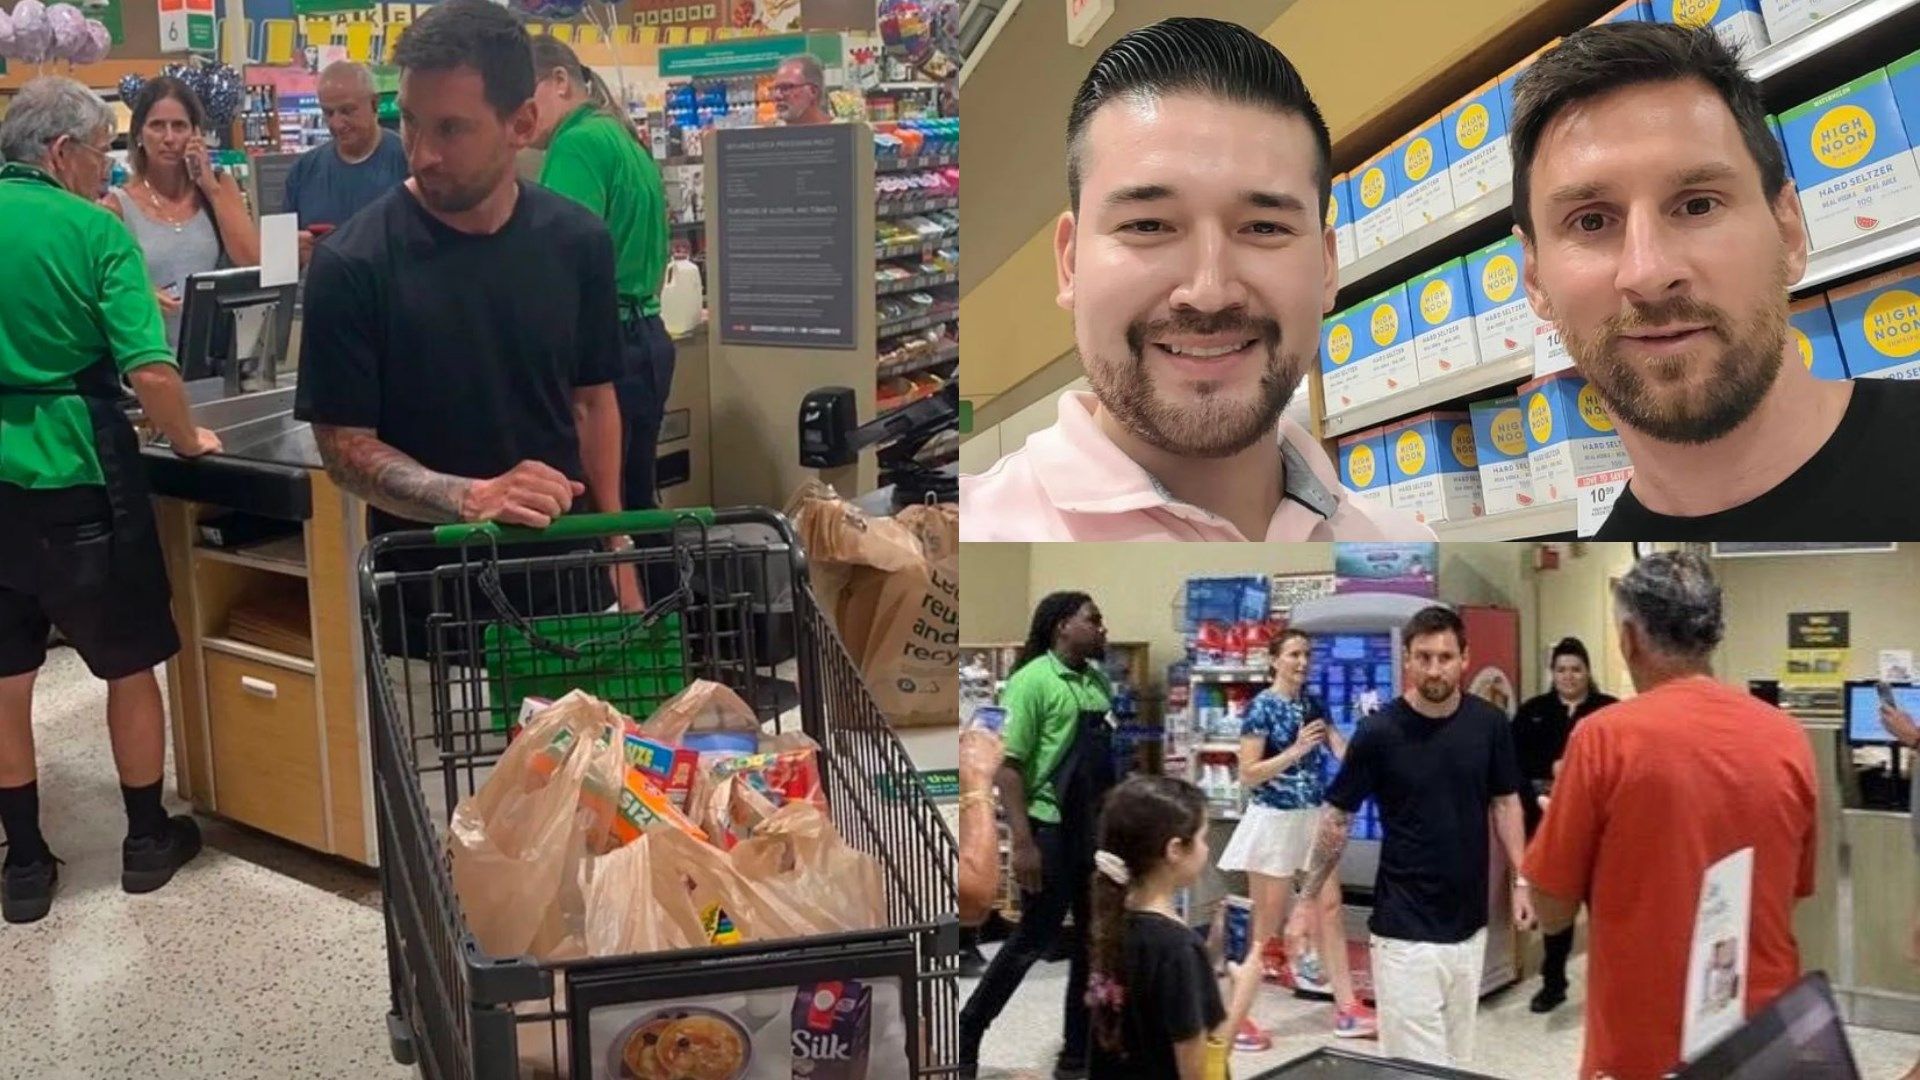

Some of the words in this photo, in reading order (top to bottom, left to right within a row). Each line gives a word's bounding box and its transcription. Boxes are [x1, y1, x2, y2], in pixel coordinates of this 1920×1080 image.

[168, 22, 178, 41] 6
[1461, 115, 1483, 131] HIGH
[1461, 121, 1485, 139] NOON
[1821, 117, 1862, 141] HIGH
[1821, 129, 1868, 155] NOON
[1409, 154, 1429, 169] NOON
[1819, 181, 1848, 198] HARD
[1849, 164, 1894, 186] SELTZER
[1488, 266, 1511, 281] HIGH
[1488, 275, 1514, 290] NOON
[1425, 291, 1445, 304] HIGH
[1424, 299, 1448, 313] NOON
[1875, 305, 1917, 326] HIGH
[1400, 443, 1419, 452] HIGH
[1583, 442, 1605, 451] HARD
[1352, 457, 1370, 466] HIGH
[1400, 451, 1422, 462] NOON
[1352, 465, 1372, 474] NOON
[1493, 463, 1514, 473] HARD
[922, 593, 959, 625] reu
[913, 617, 959, 645] and
[620, 790, 658, 824] SIZ
[791, 1029, 850, 1059] Silk
